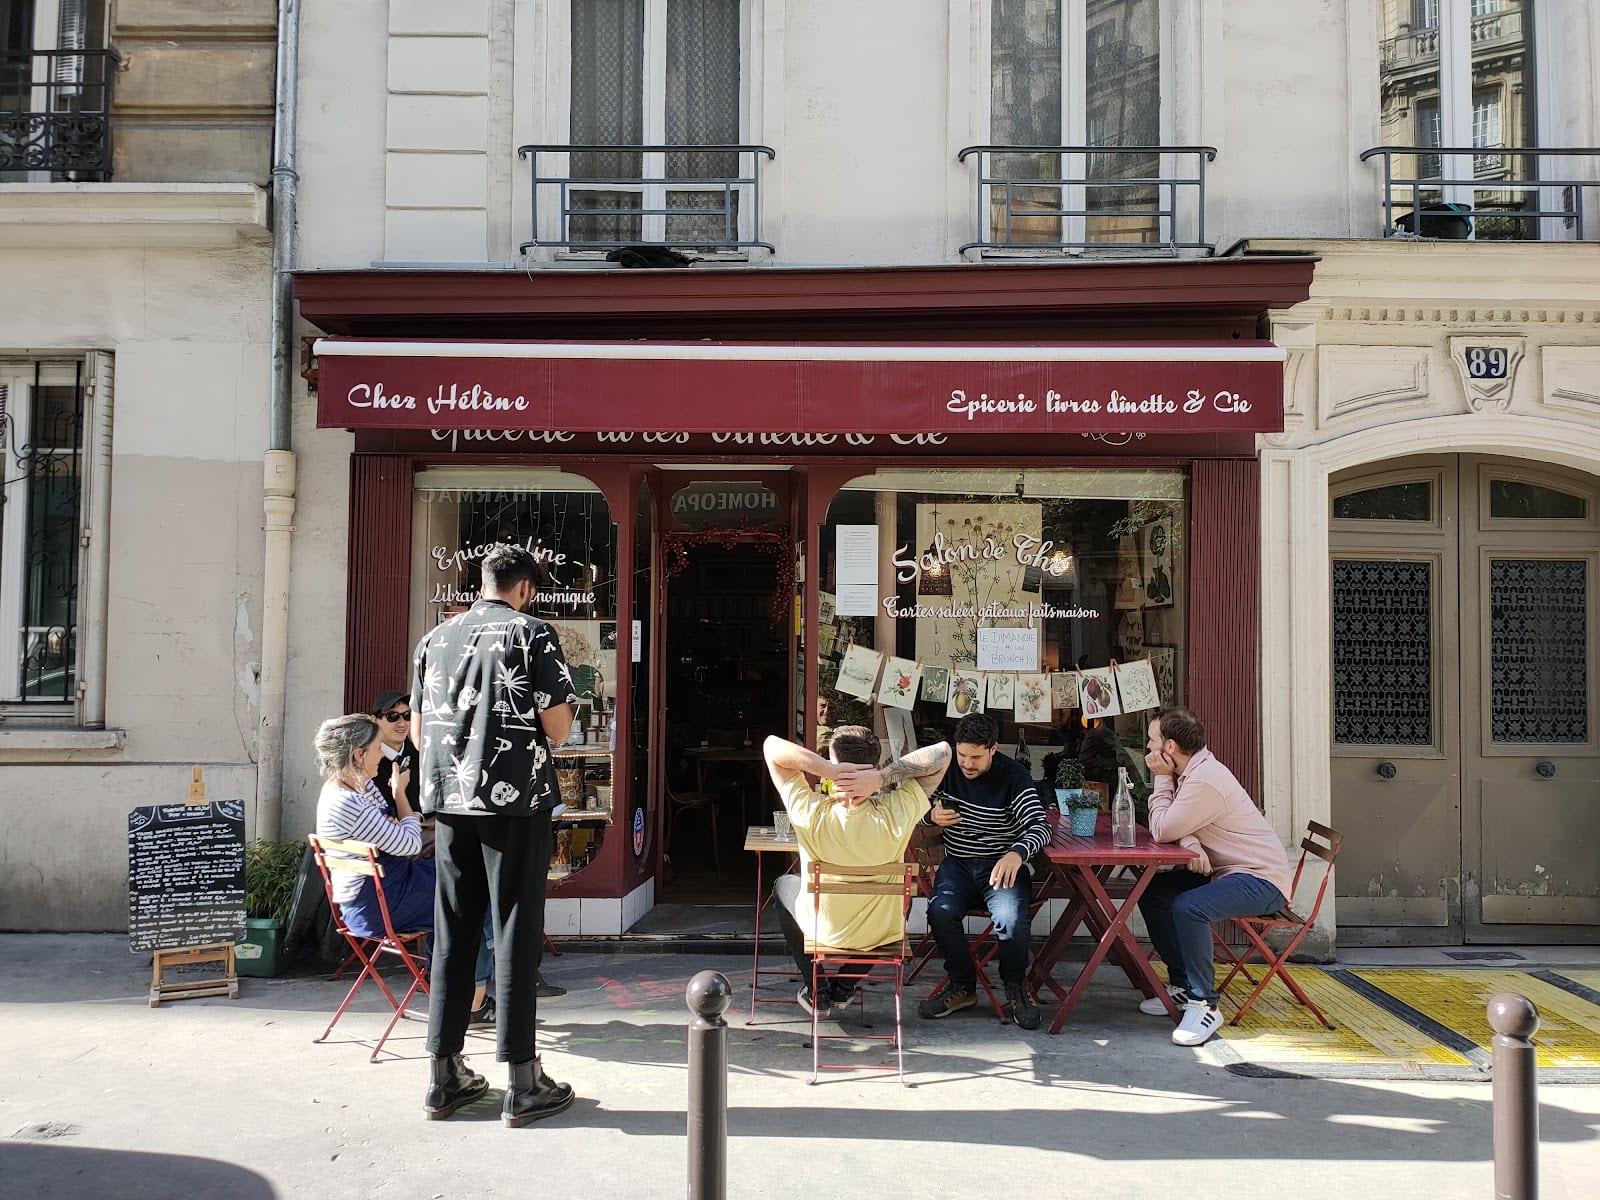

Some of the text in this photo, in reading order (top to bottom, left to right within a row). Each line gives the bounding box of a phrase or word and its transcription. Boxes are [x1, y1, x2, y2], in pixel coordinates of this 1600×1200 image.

[1469, 348, 1506, 376] 89
[347, 383, 530, 414] Chez Hélène
[946, 389, 1252, 420] Epicerie livres dînette & Cie
[891, 532, 979, 582] Salon
[982, 538, 1005, 560] de
[977, 600, 1027, 628] gâteaux
[1027, 601, 1056, 629] faits
[1056, 603, 1100, 619] maison
[991, 631, 1036, 644] DIMANCHE
